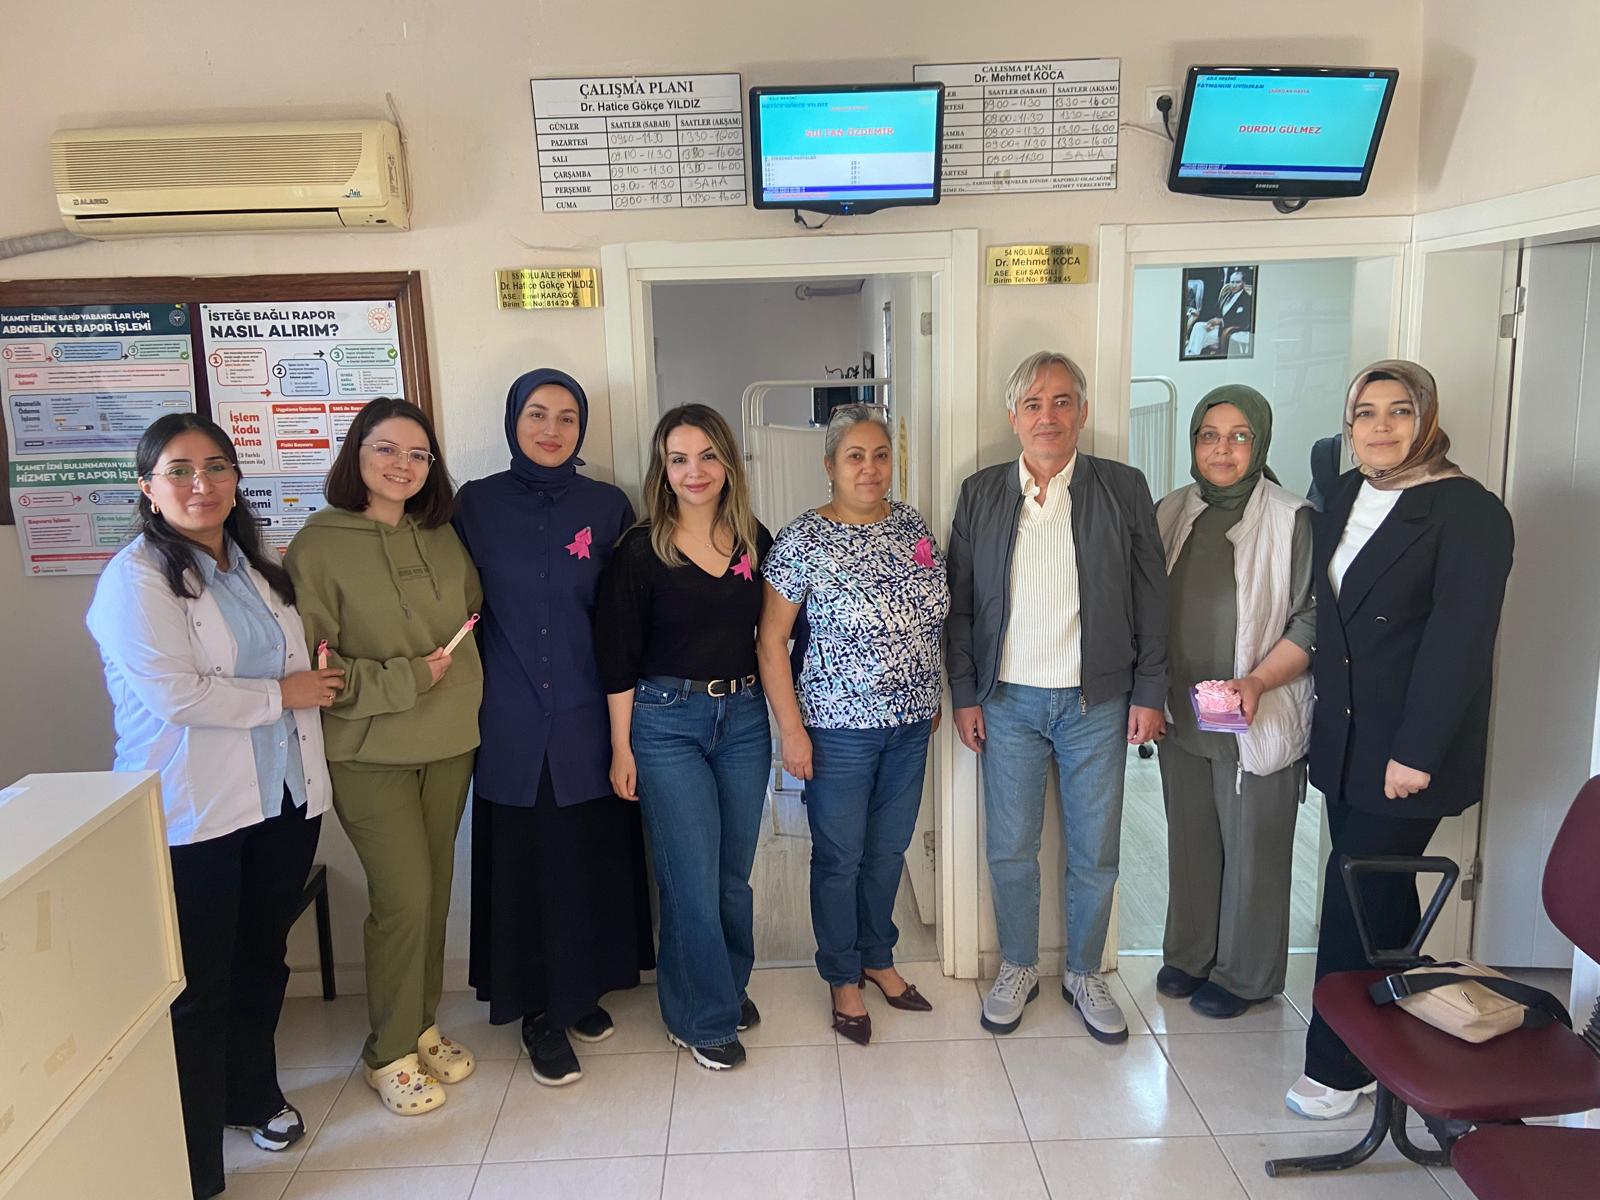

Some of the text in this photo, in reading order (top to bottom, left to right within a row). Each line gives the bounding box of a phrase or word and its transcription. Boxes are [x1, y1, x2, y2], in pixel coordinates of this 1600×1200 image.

[975, 71, 1064, 83] Dr. Mehmet KOCA
[580, 80, 693, 98] ÇALIŞMA PLANI
[581, 99, 700, 112] Dr. Hatice Gökçe YILDIZ
[549, 122, 579, 130] GÜNLER
[643, 120, 671, 129] (SABAH)
[713, 118, 741, 127] (AKŞAM)
[1279, 125, 1321, 134] GÜLMEZ
[551, 138, 588, 146] PAZARTESİ
[554, 170, 592, 179] ÇARŞAMBA
[555, 186, 592, 194] PERŞEMBE
[996, 257, 1080, 267] Dr. Mehmet KOCA
[557, 270, 581, 278] HEKİMİ
[539, 281, 564, 290] Gökçe
[566, 280, 593, 288] YILDIZ
[1, 310, 149, 322] İKAMET İZNİNE SAHİP YABANCILAR İÇİN
[208, 308, 335, 321] İSTEĞE BAĞLI RAPOR
[3, 321, 151, 334] ABONELİK VE RAPOR İŞLEMİ
[210, 324, 339, 338] NASIL ALIRIM?
[230, 410, 259, 423] İşlem
[232, 425, 260, 434] Kodu
[234, 437, 262, 447] Alma
[16, 472, 57, 482] HİZMET
[59, 472, 76, 481] VE
[78, 471, 117, 480] RAPOR
[242, 488, 272, 497] deme
[248, 499, 271, 508] lemi
